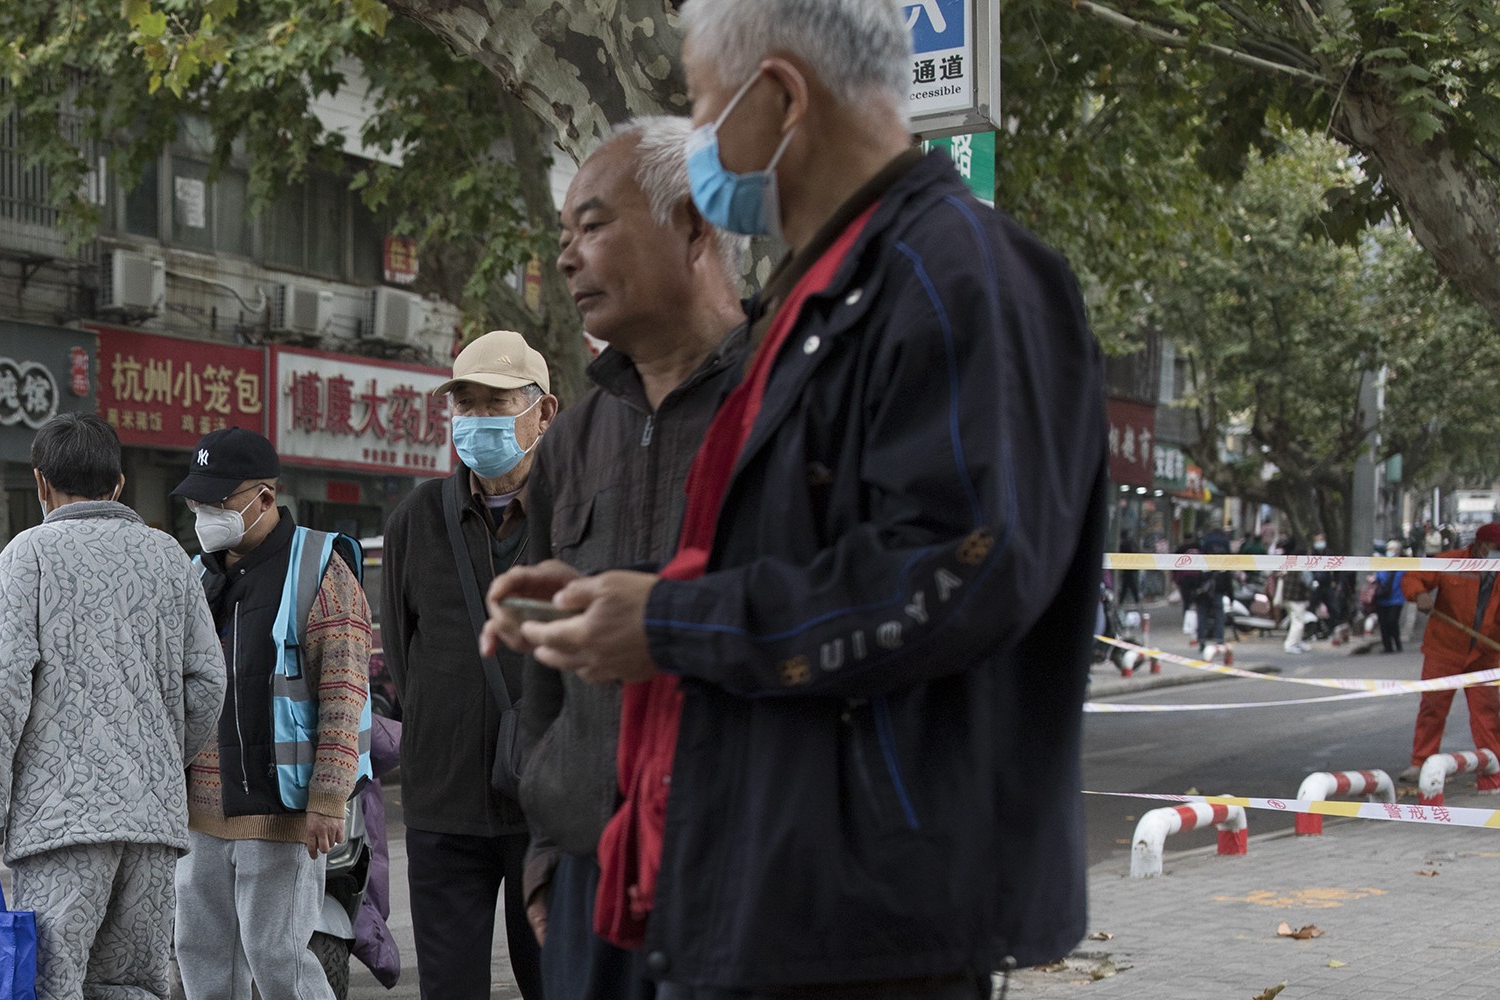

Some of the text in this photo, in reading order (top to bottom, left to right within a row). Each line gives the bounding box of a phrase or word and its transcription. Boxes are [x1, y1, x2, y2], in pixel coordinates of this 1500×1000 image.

[912, 54, 964, 85] 通道
[909, 85, 962, 101] ccessible
[111, 352, 262, 415] 杭州小笼包
[286, 369, 450, 448] 博康大药房
[1382, 802, 1452, 823] 警戒线
